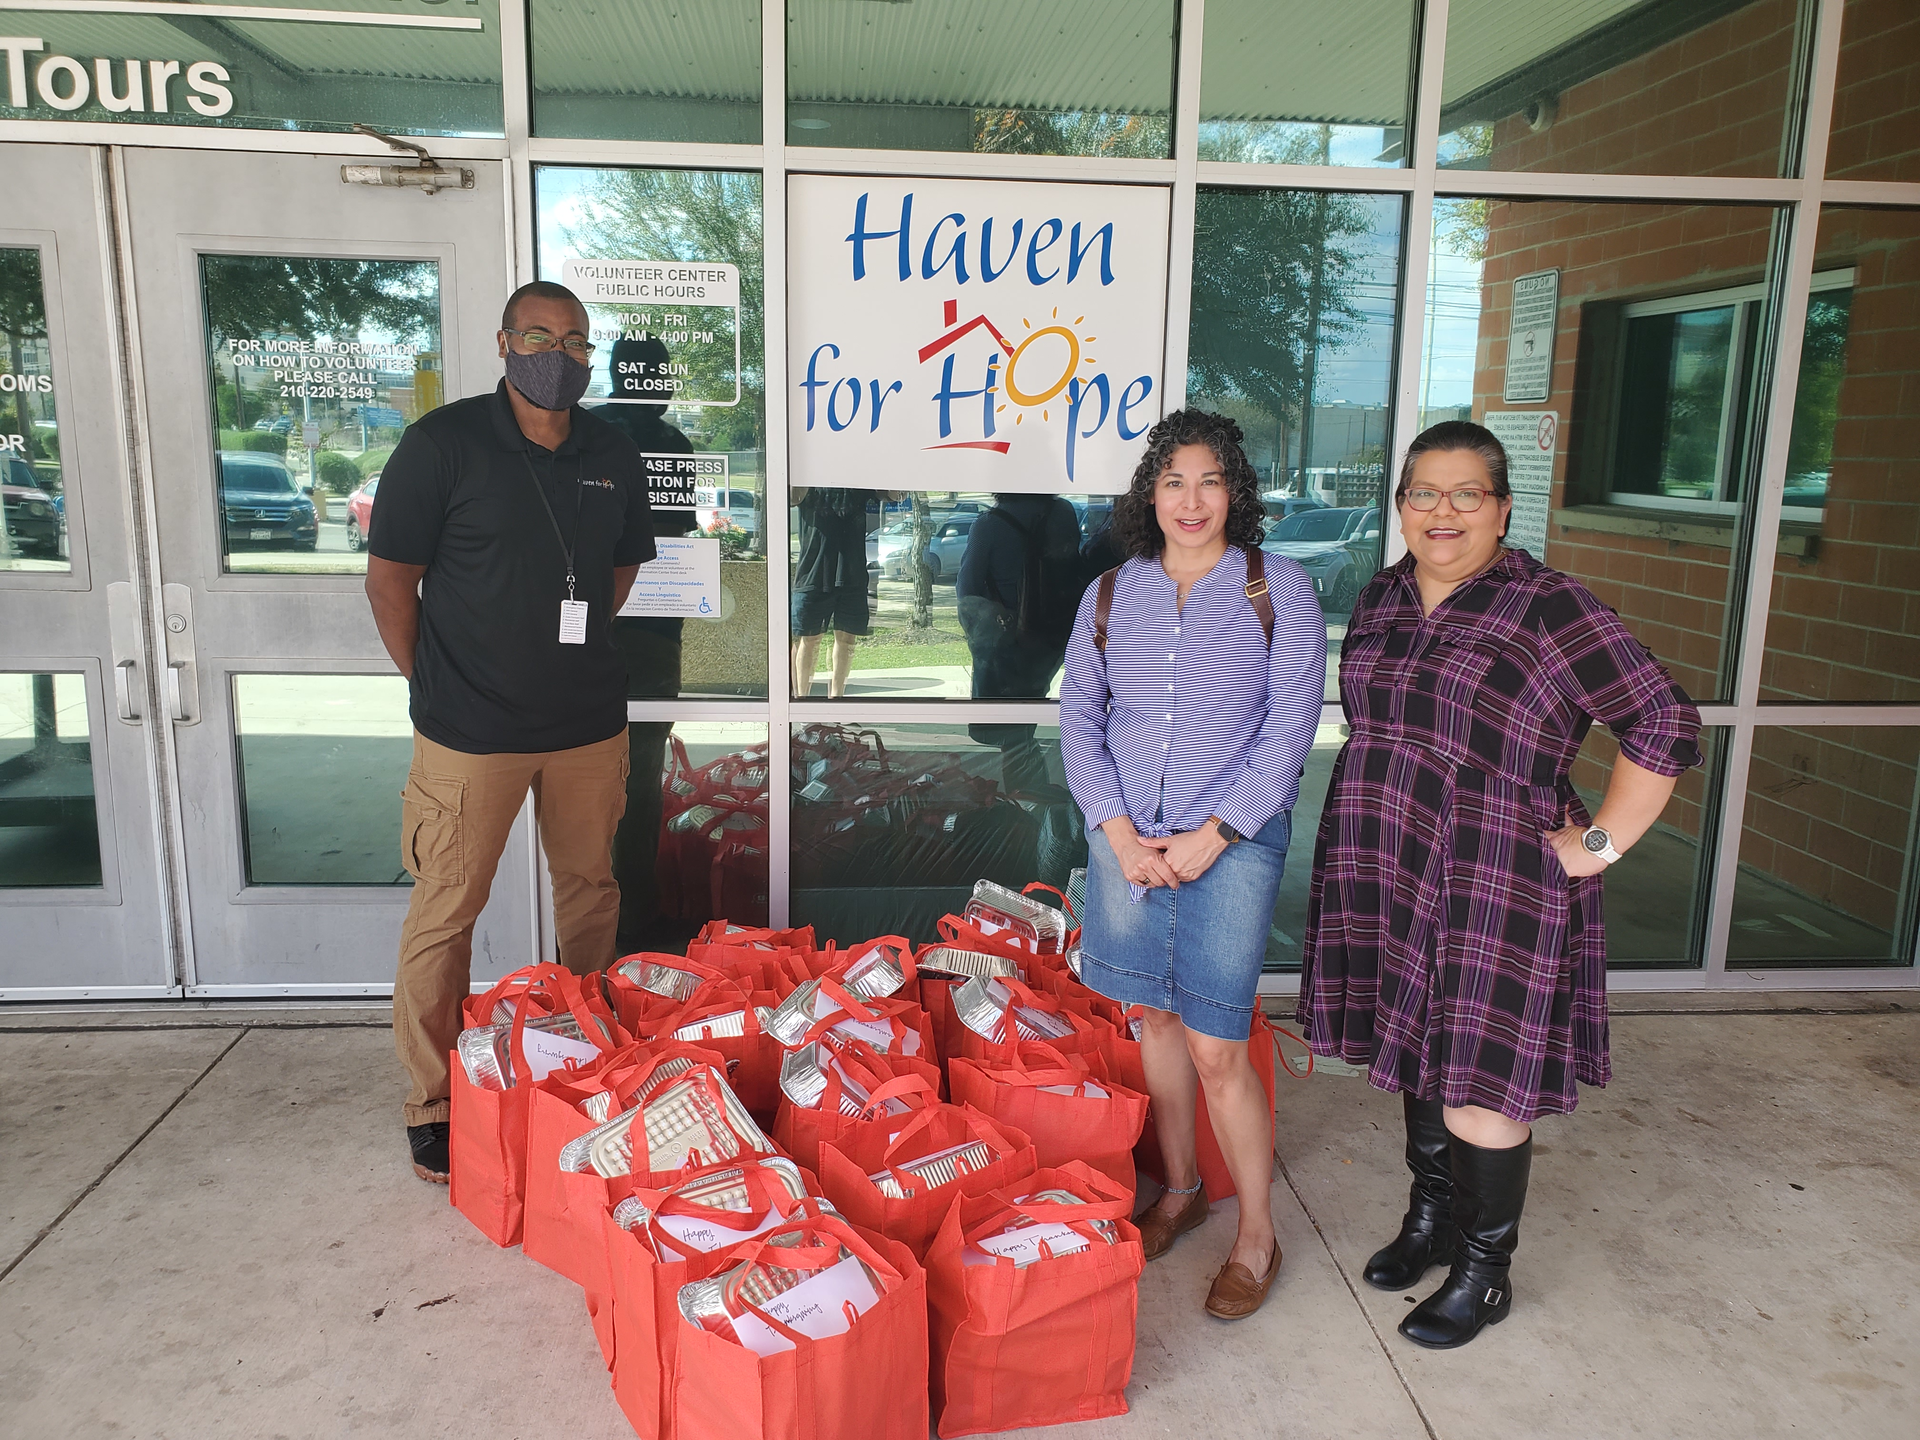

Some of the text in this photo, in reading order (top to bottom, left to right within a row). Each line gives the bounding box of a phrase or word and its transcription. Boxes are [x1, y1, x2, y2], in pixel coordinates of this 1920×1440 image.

[0, 37, 234, 117] Tours
[844, 192, 1115, 286] Haven
[574, 266, 727, 283] VOLUNTEER CENTER
[596, 283, 706, 298] PUBLIC HOURS
[618, 313, 651, 326] MON
[664, 314, 688, 327] FRI
[593, 329, 621, 341] 9:00
[624, 330, 647, 342] AM
[660, 331, 688, 343] 4:00
[693, 332, 714, 344] PM
[229, 339, 418, 356] FOR MORE INFORMATION
[233, 354, 416, 370] ON HOW TO VOLUNTEER
[618, 361, 646, 374] SAT
[659, 362, 689, 375] SUN
[274, 372, 377, 384] PLEASE CALL
[624, 378, 684, 391] CLOSED
[280, 385, 372, 399] 210-220-2549
[798, 325, 1153, 483] for Hope
[677, 461, 722, 473] PRESS
[686, 477, 716, 489] FOR
[682, 1228, 716, 1242] Happy
